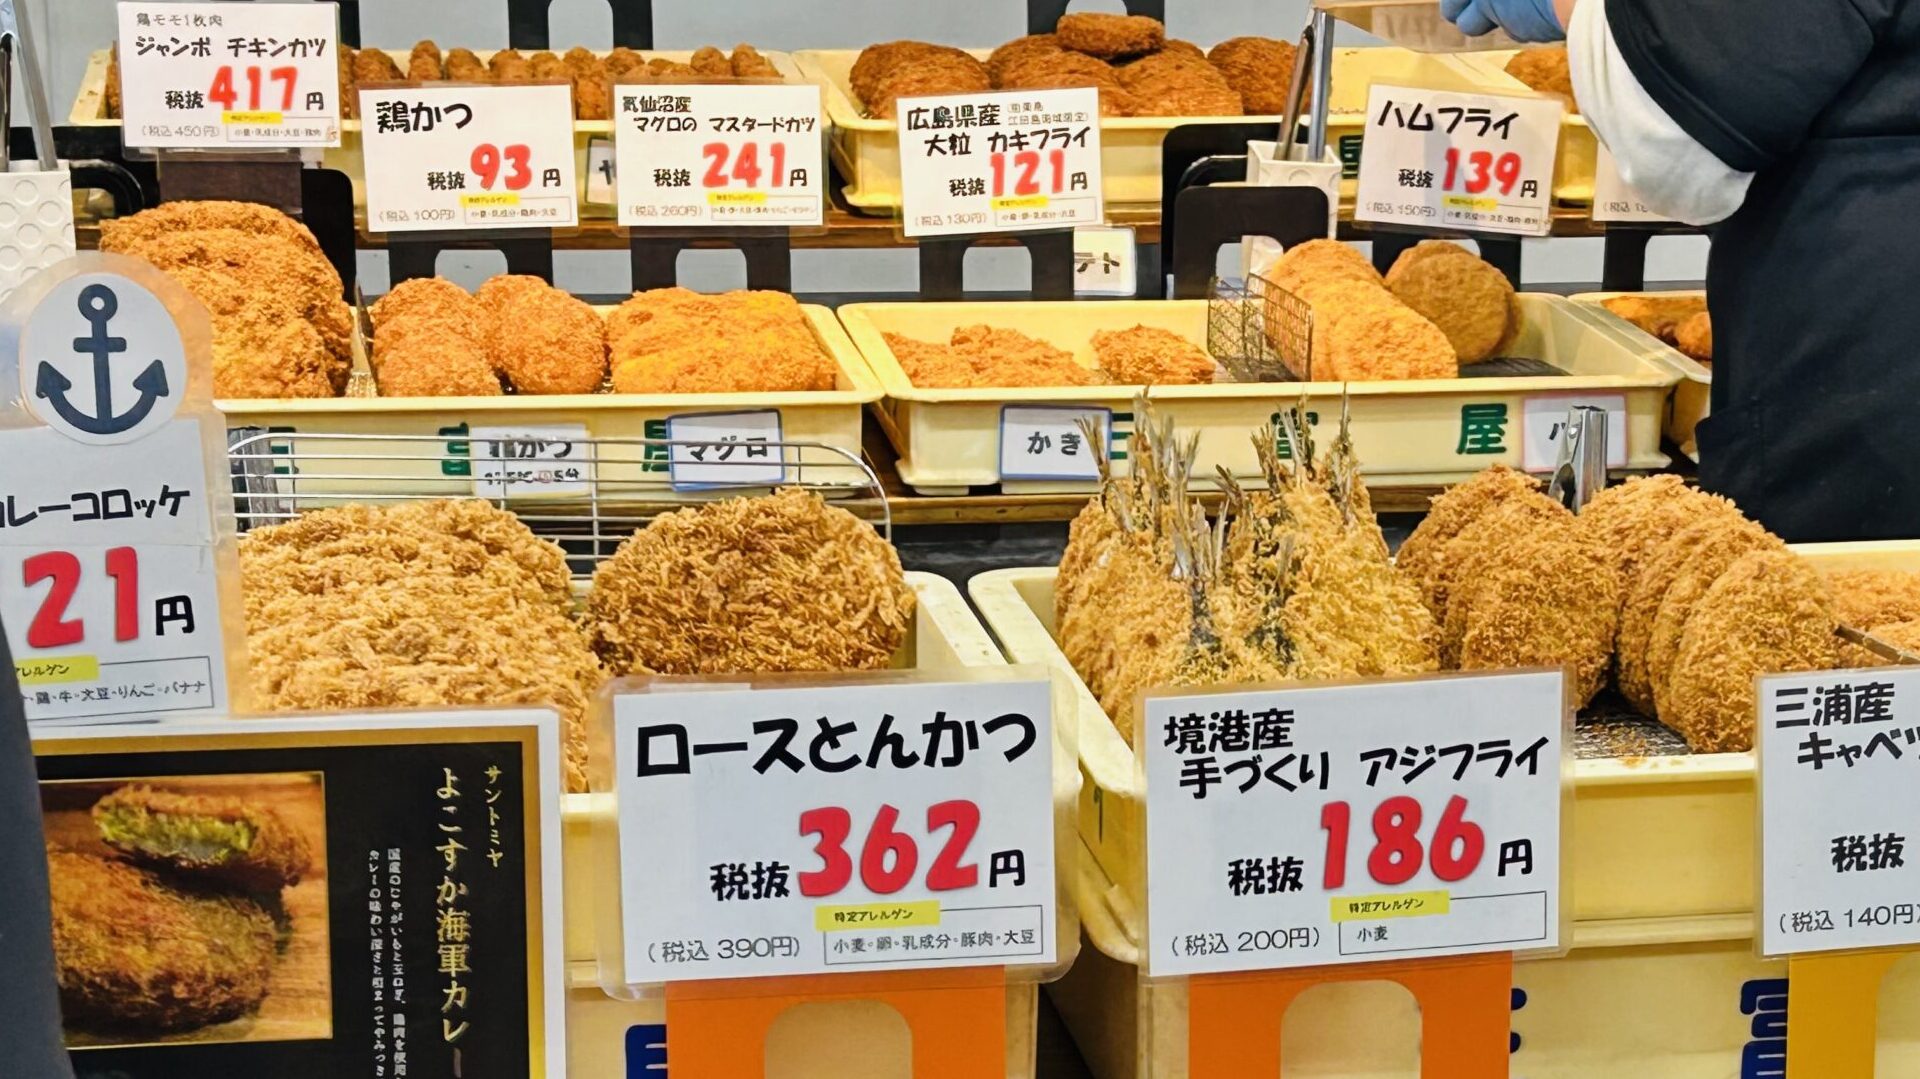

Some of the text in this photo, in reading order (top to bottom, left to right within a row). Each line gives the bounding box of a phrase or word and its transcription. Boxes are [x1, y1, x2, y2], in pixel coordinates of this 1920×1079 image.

[136, 36, 326, 57] ジャンボ チキンカツ
[164, 66, 324, 110] 税抜 417 円
[622, 95, 692, 113] 気仙沼産
[376, 101, 473, 134] 鶏かつ
[633, 116, 816, 133] マグロの マスタードカツ
[907, 103, 1001, 130] 広島県産
[1377, 100, 1519, 140] ハムフライ
[924, 126, 1091, 157] 大粒 カキフライ
[427, 143, 561, 191] 税抜 93 円
[653, 142, 808, 188] 税抜 241 円
[949, 149, 1088, 197] 税抜 121 円
[1398, 147, 1538, 198] 税抜 139 円
[686, 435, 768, 461] マグロ
[1027, 431, 1082, 456] かき
[1456, 403, 1508, 455] 屋
[0, 485, 190, 528] レーコロッケ
[22, 546, 195, 649] 21 円
[1775, 682, 1895, 729] 三浦産
[637, 711, 1037, 778] ロースとんかつ
[1164, 708, 1295, 754] 境港産
[1179, 736, 1549, 800] 手づくり アジフライ
[484, 765, 503, 868] サントミヤ
[709, 800, 1026, 901] 税抜 362 円
[1228, 794, 1534, 896] 税抜 186 円
[1831, 833, 1905, 873] 税抜
[435, 767, 472, 1079] よこすか海軍カレー
[1171, 926, 1320, 957] (税込 200円)
[1357, 925, 1388, 942] 小麦
[1779, 911, 1834, 933] (税込
[648, 935, 800, 963] (税込 390円)
